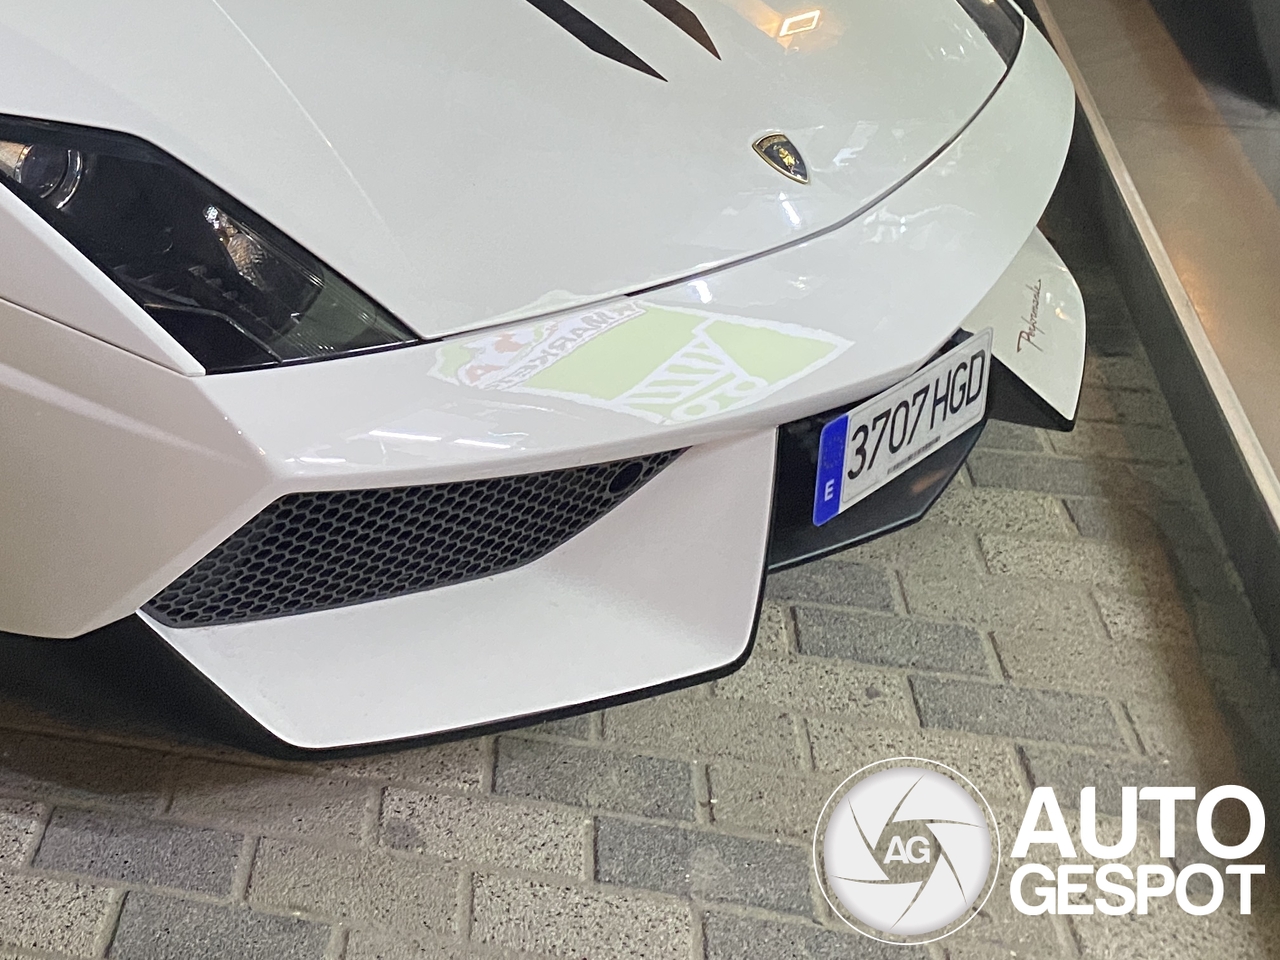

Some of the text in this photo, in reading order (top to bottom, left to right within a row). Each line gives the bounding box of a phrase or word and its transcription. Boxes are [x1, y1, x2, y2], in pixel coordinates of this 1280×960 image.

[847, 384, 931, 480] 3707
[929, 348, 986, 430] HGD
[824, 478, 835, 502] E
